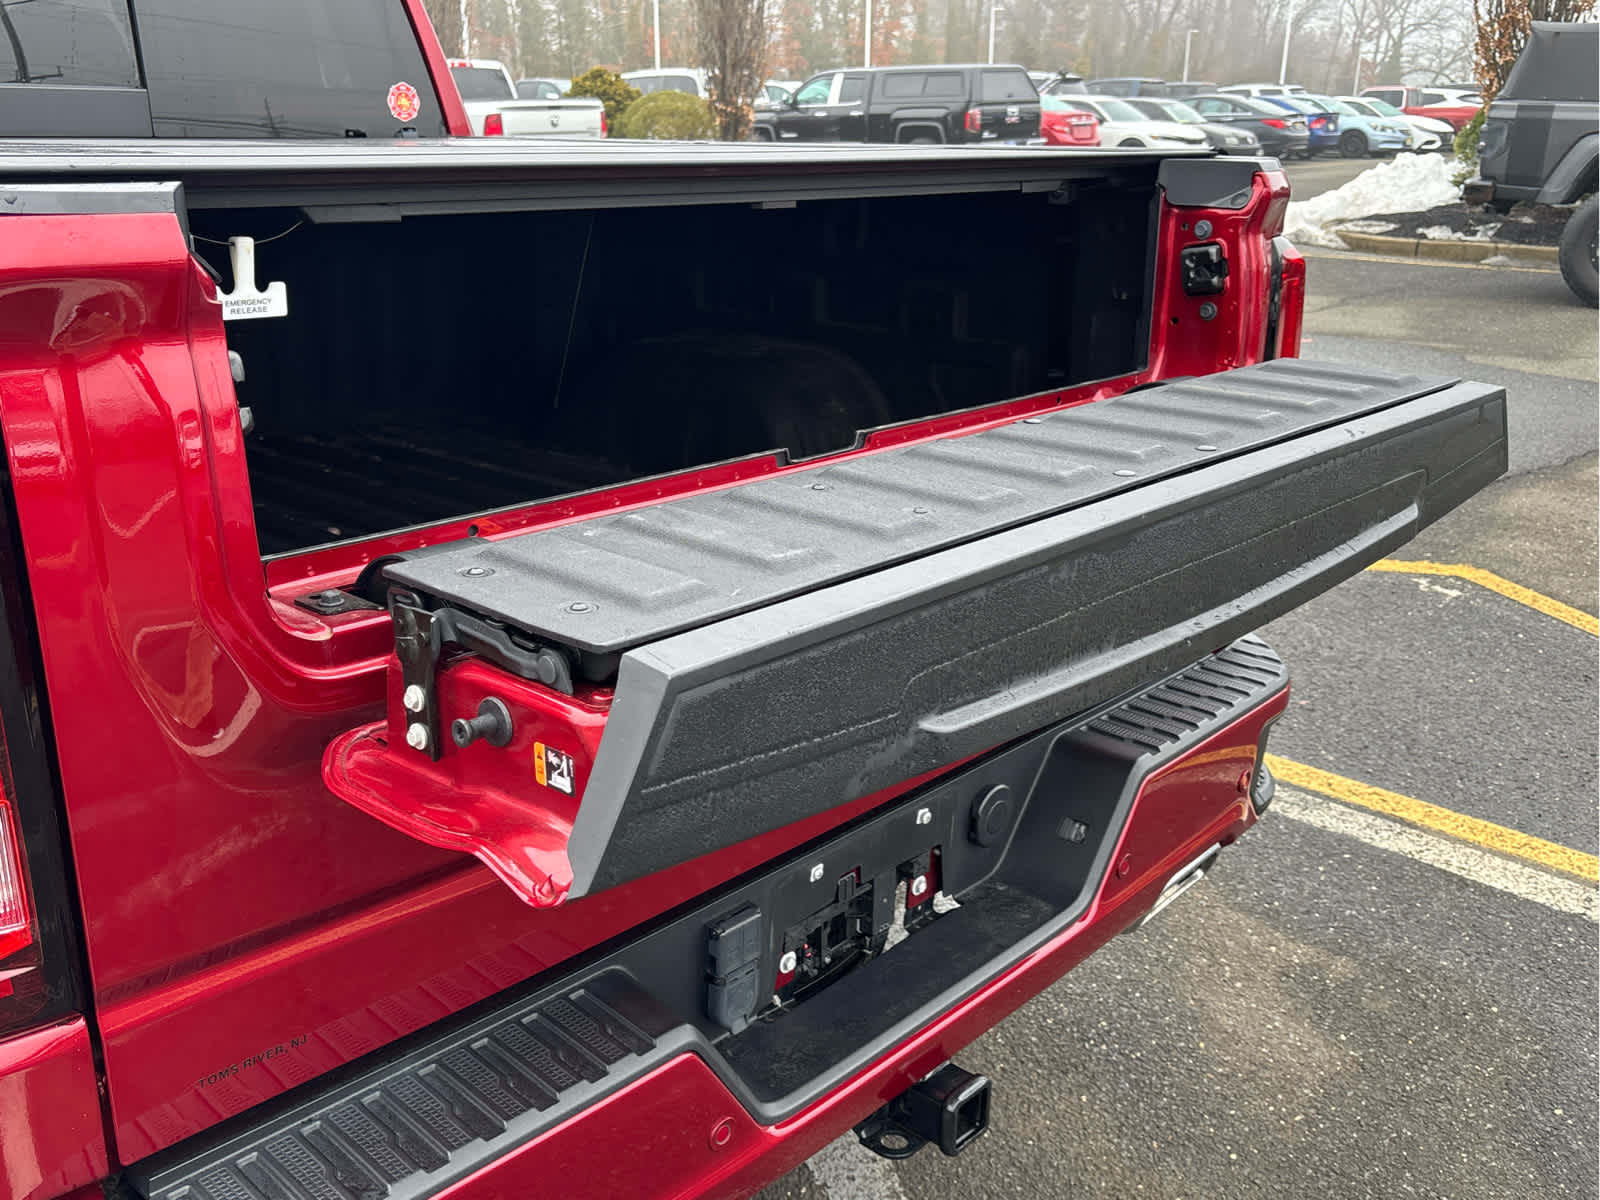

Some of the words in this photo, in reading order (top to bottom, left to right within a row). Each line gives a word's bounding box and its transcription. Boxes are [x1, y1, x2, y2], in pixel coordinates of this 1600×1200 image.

[225, 298, 272, 307] EMERGENCY
[230, 306, 268, 315] RELEASE
[198, 1064, 239, 1088] TOMS
[242, 1045, 289, 1069] RIVER,
[290, 1034, 307, 1048] NJ
